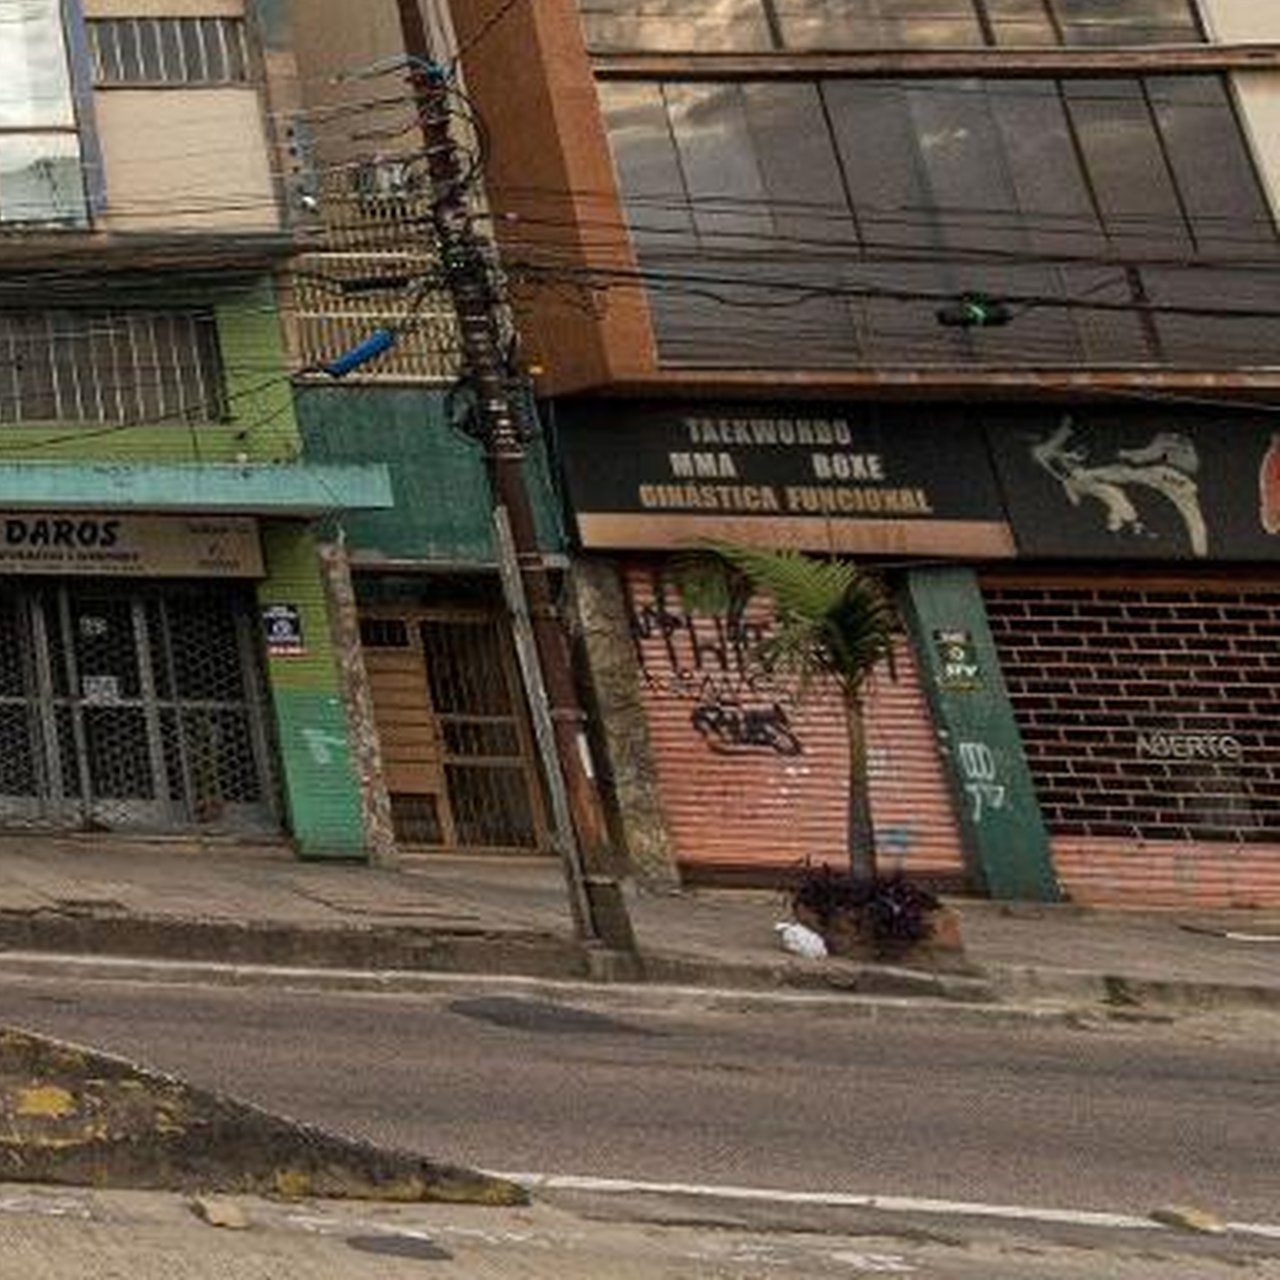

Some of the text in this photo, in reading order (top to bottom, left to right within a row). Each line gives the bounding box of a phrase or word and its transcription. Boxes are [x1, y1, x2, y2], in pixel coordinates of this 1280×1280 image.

[686, 418, 852, 445] TAEKWONDO
[669, 452, 886, 480] MMA BOXE
[784, 486, 934, 514] FUNCIONAL
[4, 519, 121, 548] DAROS
